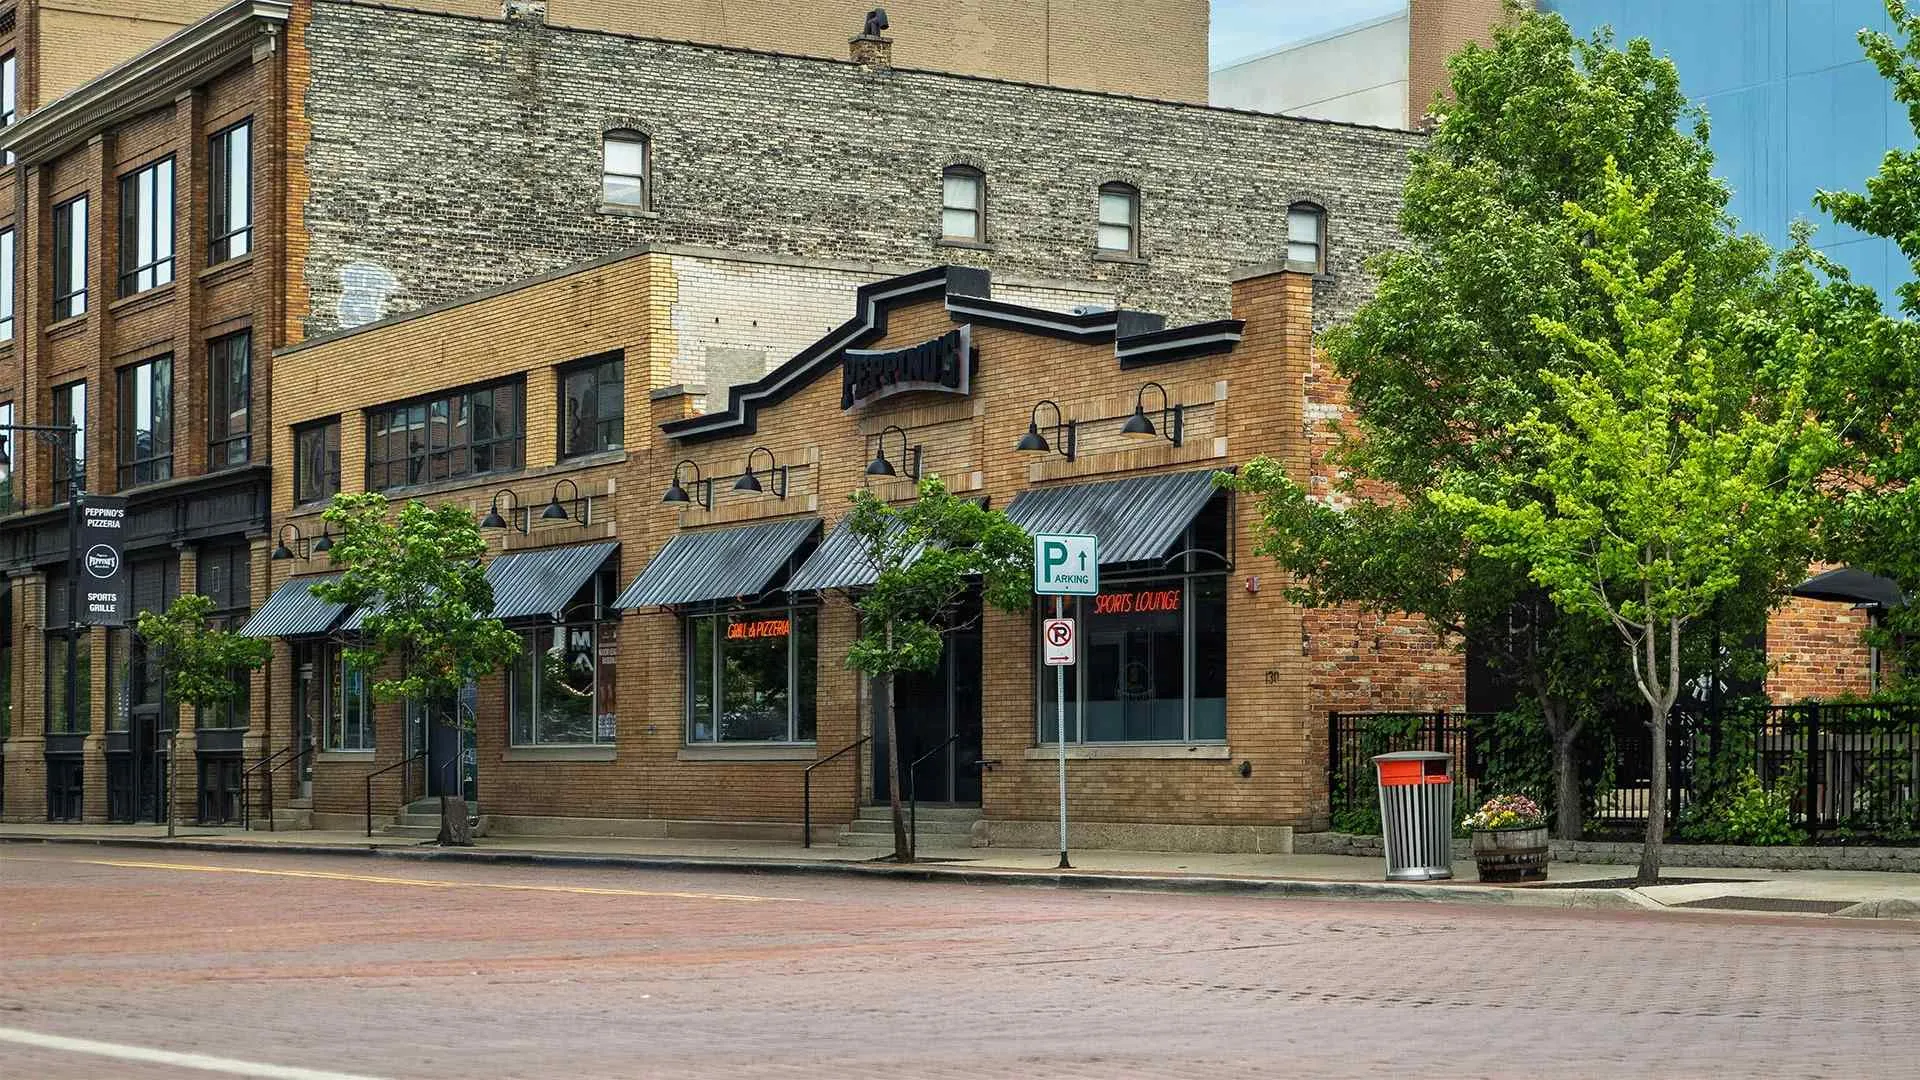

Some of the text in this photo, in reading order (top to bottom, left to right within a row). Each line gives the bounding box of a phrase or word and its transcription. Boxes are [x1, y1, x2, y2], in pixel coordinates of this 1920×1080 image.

[841, 329, 961, 411] PEPPINO'S
[85, 507, 124, 518] PEPPINO'S
[87, 519, 121, 528] PIZZERIA
[87, 592, 118, 602] SPORTS
[1093, 590, 1180, 615] SPORTS LOUNGE
[89, 603, 116, 613] GRILLE
[757, 618, 791, 638] PIZZERIA
